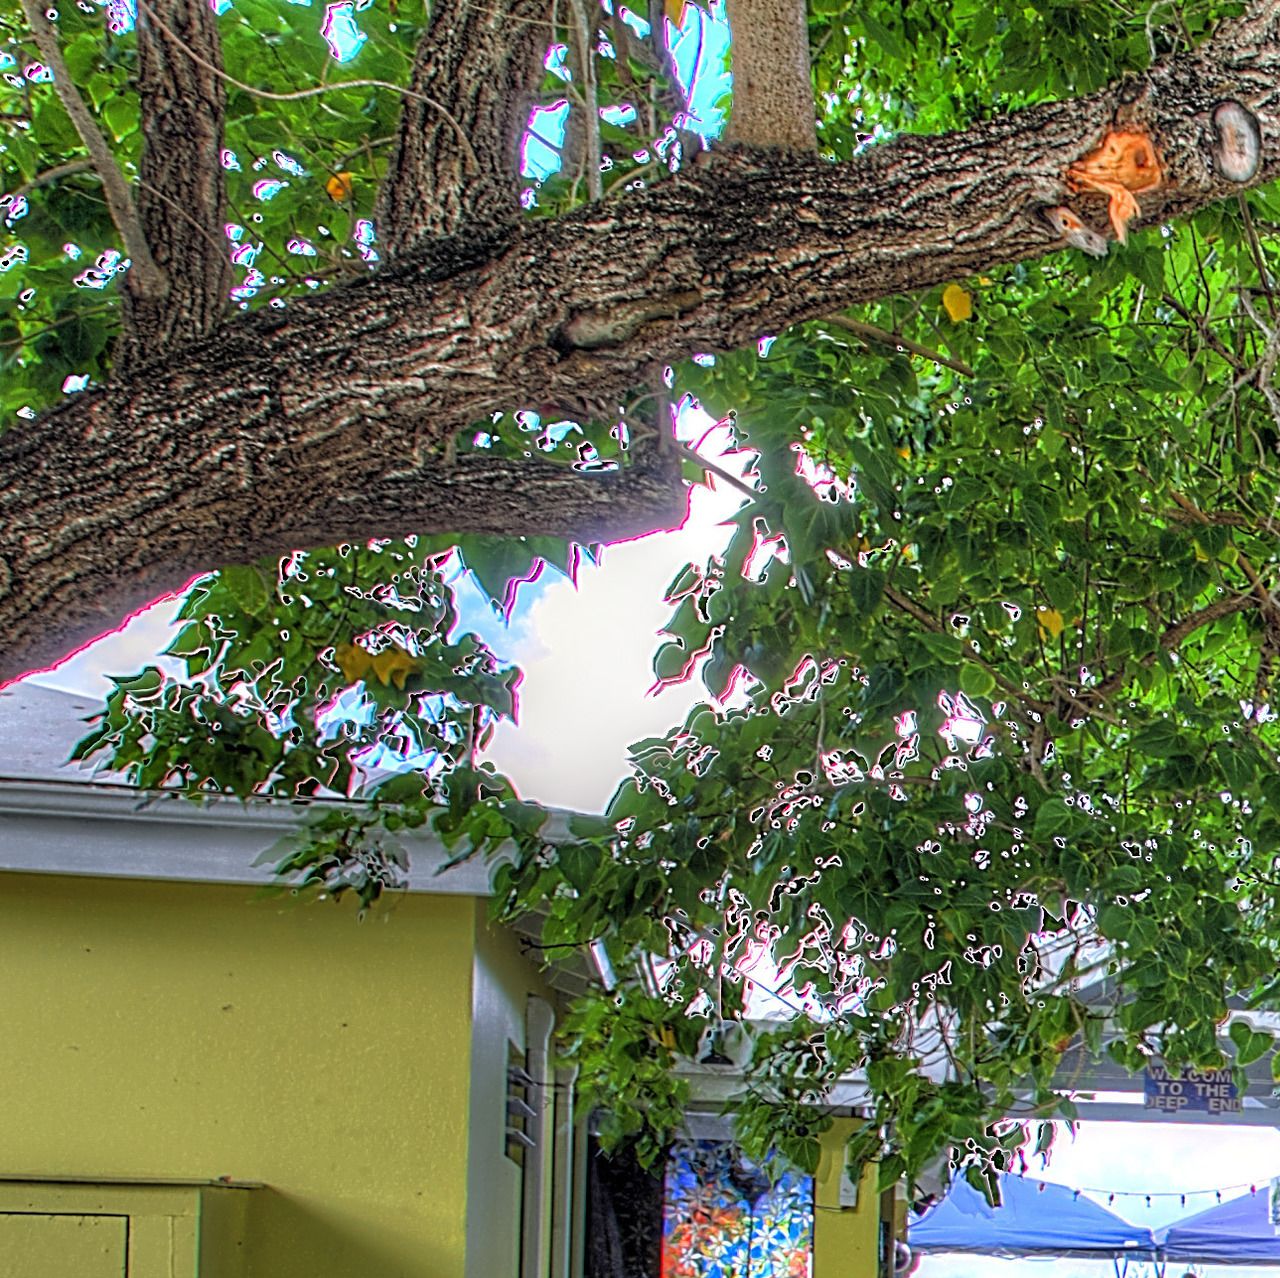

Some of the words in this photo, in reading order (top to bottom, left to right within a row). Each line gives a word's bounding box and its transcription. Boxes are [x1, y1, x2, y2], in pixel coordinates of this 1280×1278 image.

[1156, 1082, 1183, 1096] TO
[1194, 1084, 1231, 1097] THE
[1208, 1098, 1241, 1112] END
